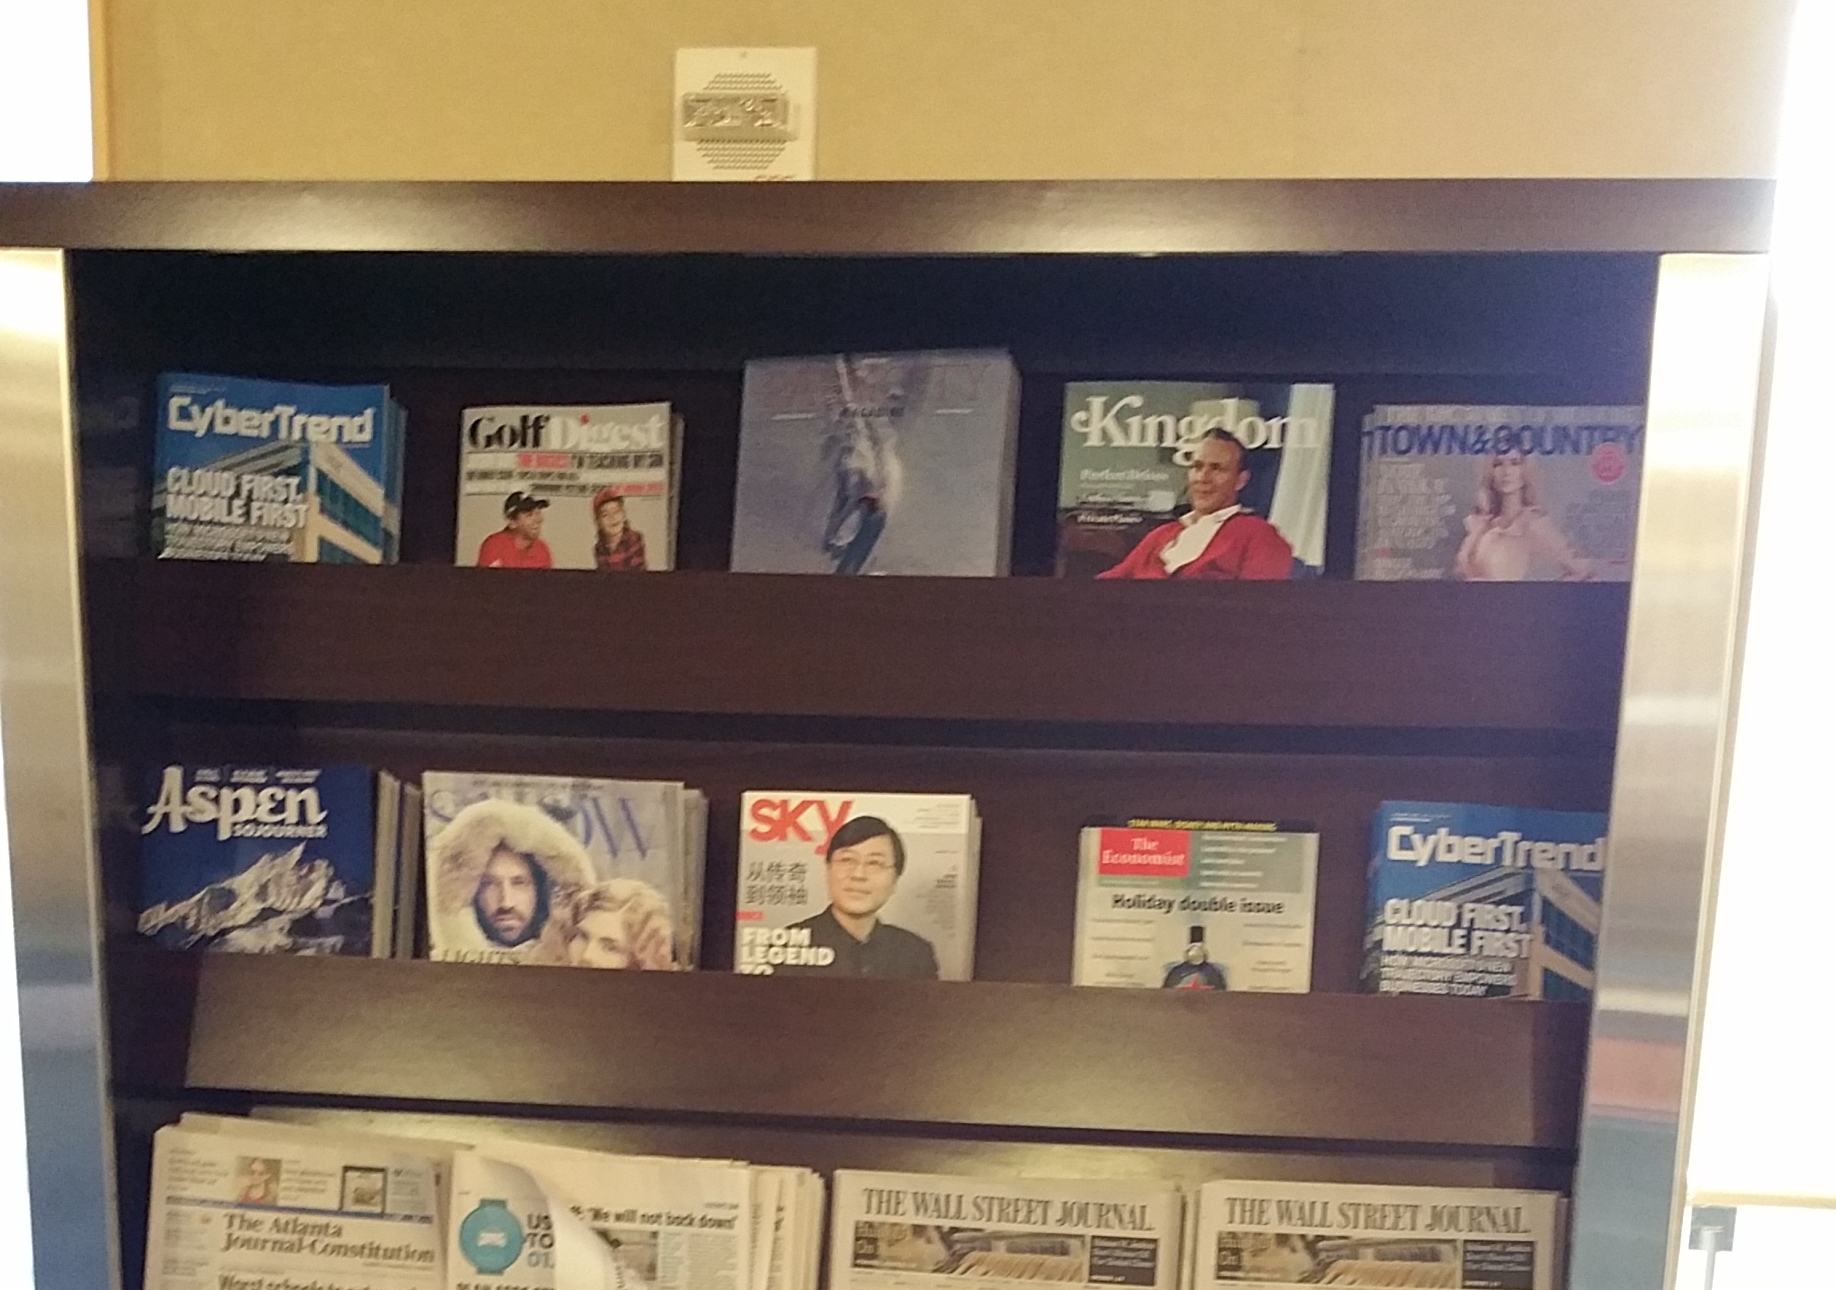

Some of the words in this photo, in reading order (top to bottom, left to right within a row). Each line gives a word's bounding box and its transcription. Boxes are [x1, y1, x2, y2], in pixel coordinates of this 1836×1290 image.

[168, 395, 377, 443] CyberTrend
[468, 413, 551, 449] Golf
[166, 493, 248, 525] MOBILE
[250, 501, 309, 529] FIRST
[141, 764, 330, 841] Aspen
[749, 798, 855, 856] SKY
[1130, 836, 1161, 851] The
[1101, 850, 1186, 867] Economist
[1386, 825, 1607, 872] CyberTrend
[1111, 894, 1176, 914] Holiday
[1178, 895, 1237, 913] double
[741, 927, 812, 946] FROM
[1382, 925, 1468, 955] MOBILE
[1470, 930, 1533, 959] FIRST
[741, 946, 836, 966] LEGEND
[222, 1212, 264, 1233] The
[270, 1215, 343, 1239] Atlanta
[613, 1208, 638, 1223] will
[640, 1211, 663, 1226] not
[665, 1211, 696, 1228] back
[863, 1188, 907, 1216] THE
[910, 1191, 967, 1222] WALL
[972, 1195, 1051, 1226] STREET
[1056, 1200, 1156, 1232] JOURNAL
[1225, 1196, 1272, 1226] THE
[1275, 1199, 1333, 1229] WALL
[1337, 1200, 1419, 1233] STREET
[1424, 1204, 1532, 1235] JOURNAL
[222, 1231, 436, 1264] Journal-Constitution
